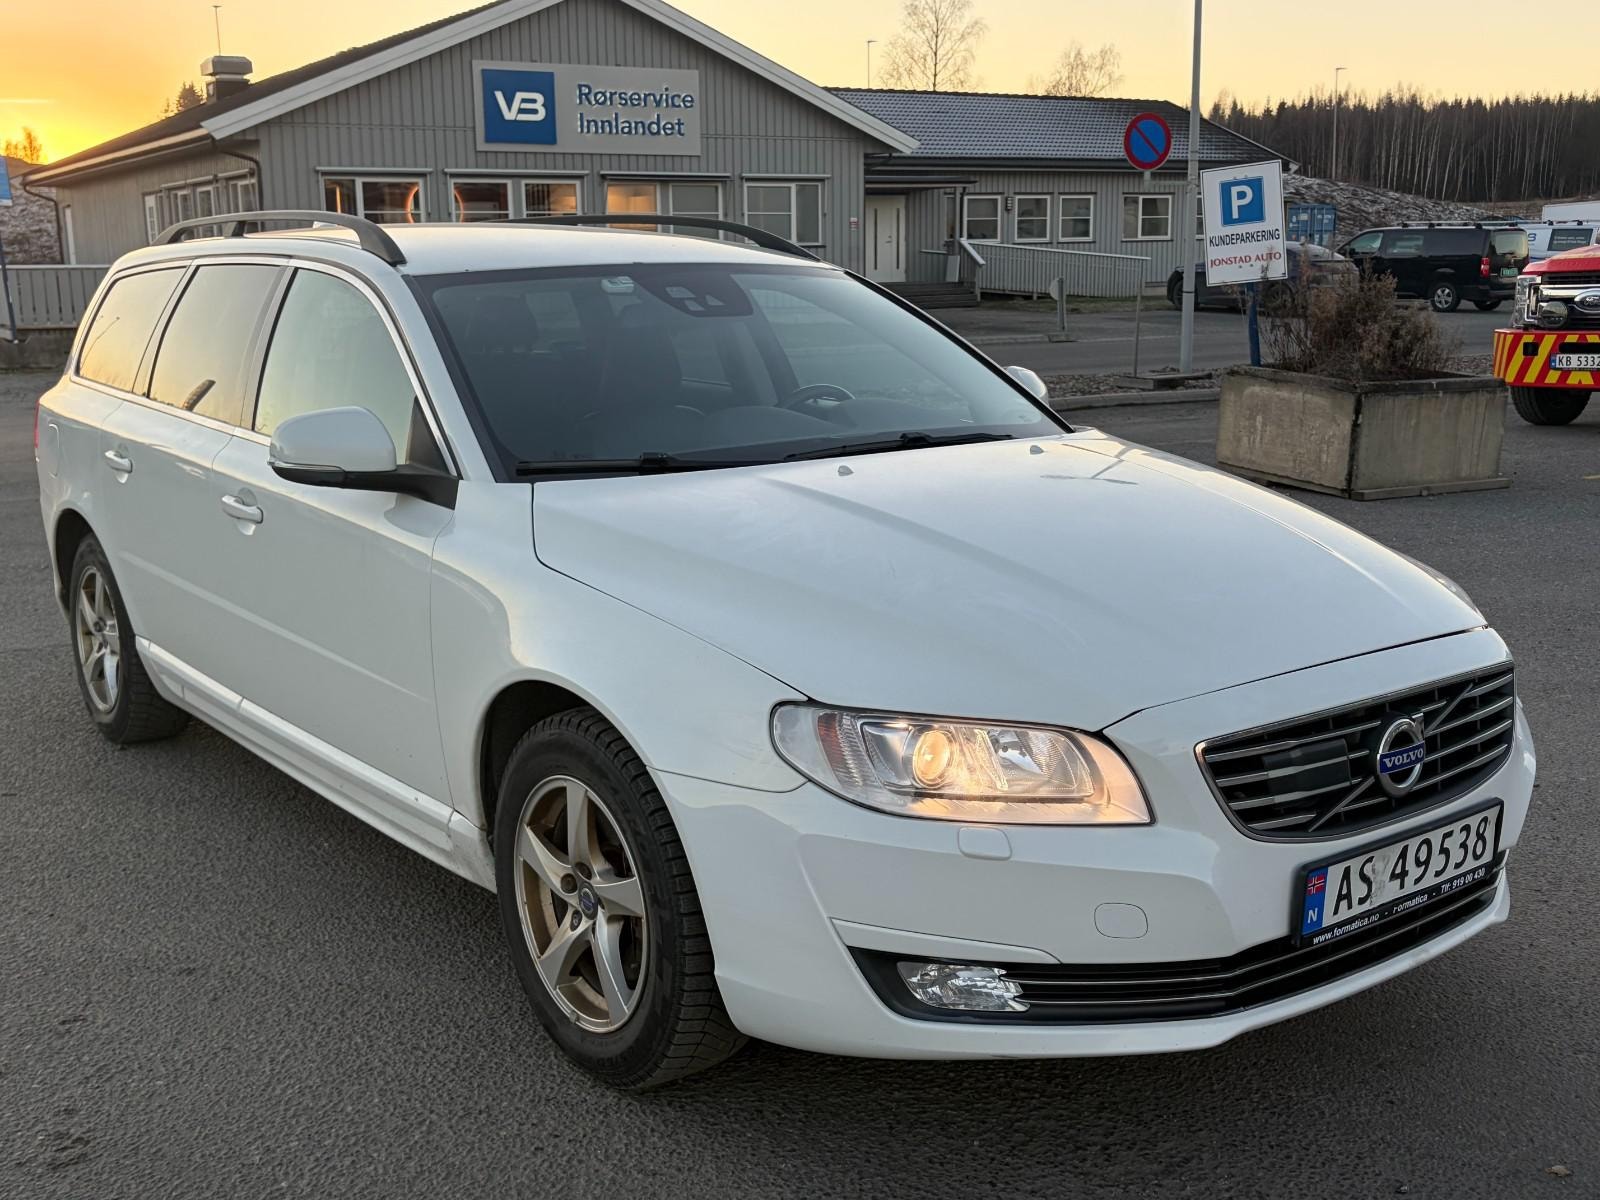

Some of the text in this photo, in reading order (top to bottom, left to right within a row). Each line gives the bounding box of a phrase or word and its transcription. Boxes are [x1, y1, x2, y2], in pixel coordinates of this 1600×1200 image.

[494, 90, 546, 121] VB
[576, 83, 695, 109] Rørservice
[577, 112, 685, 137] Innlandet
[1230, 185, 1253, 219] P
[1209, 228, 1280, 247] KUNDEPARKERING
[1210, 251, 1282, 268] JONSTAD AUTO
[1558, 355, 1572, 367] KB
[1383, 748, 1423, 768] VOLVO
[1333, 815, 1489, 916] AS 49538
[1307, 908, 1319, 924] N
[1313, 914, 1380, 945] www.formatica.no
[1452, 875, 1465, 889] 919
[1465, 873, 1474, 884] 00
[1474, 868, 1486, 879] 430
